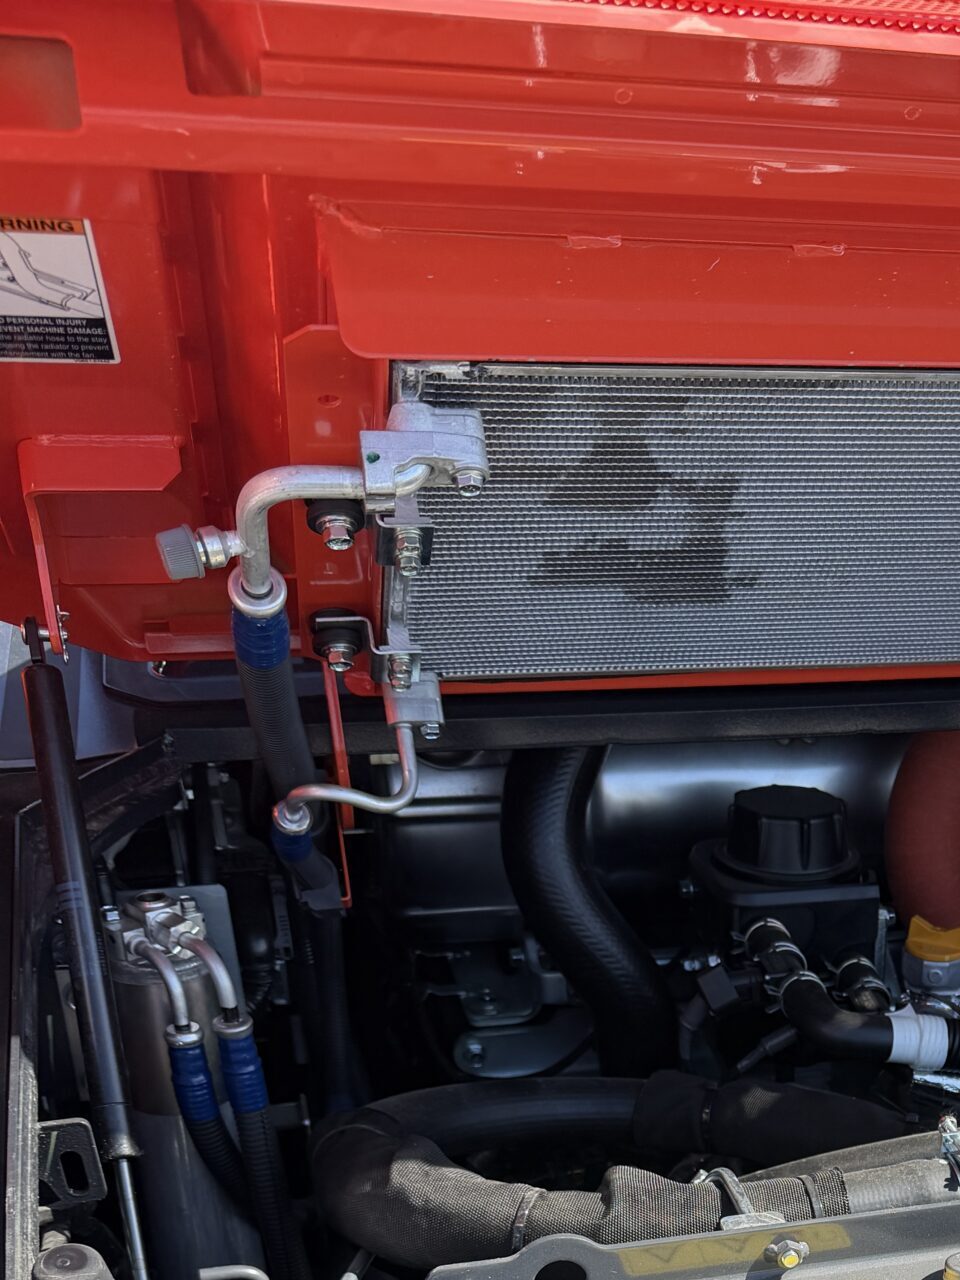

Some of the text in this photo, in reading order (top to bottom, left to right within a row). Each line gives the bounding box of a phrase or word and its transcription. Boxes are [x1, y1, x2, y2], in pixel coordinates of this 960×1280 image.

[6, 317, 54, 325] PERSONAL
[26, 326, 65, 334] MACHINE
[67, 327, 107, 335] DAMAGE:
